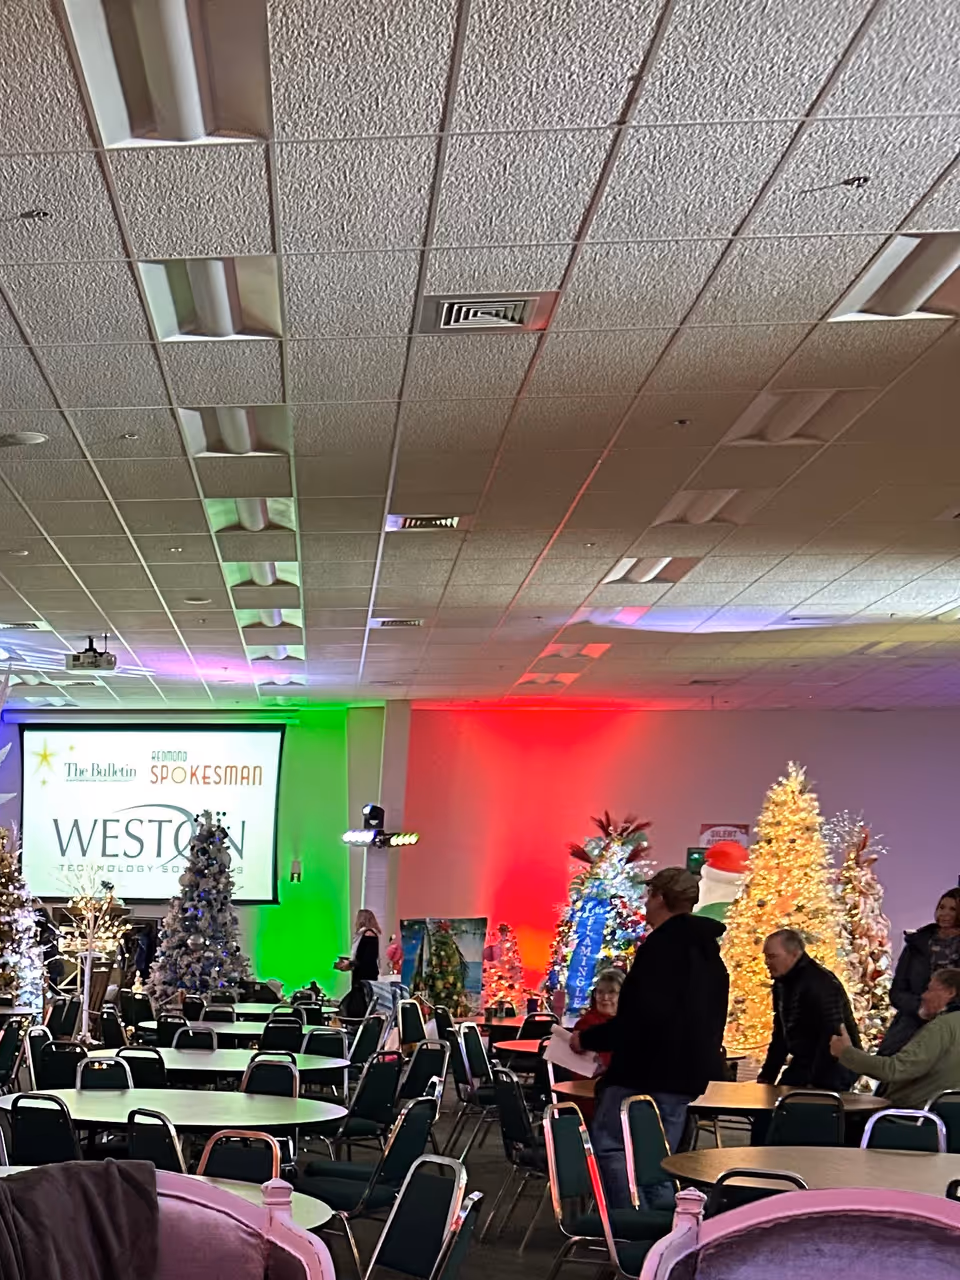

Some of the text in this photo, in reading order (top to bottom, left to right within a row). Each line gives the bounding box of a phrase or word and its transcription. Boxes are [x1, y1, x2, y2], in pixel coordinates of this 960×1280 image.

[151, 750, 188, 762] REDMOND
[64, 762, 137, 778] The Bulletin
[150, 765, 263, 786] SPOKESMAN
